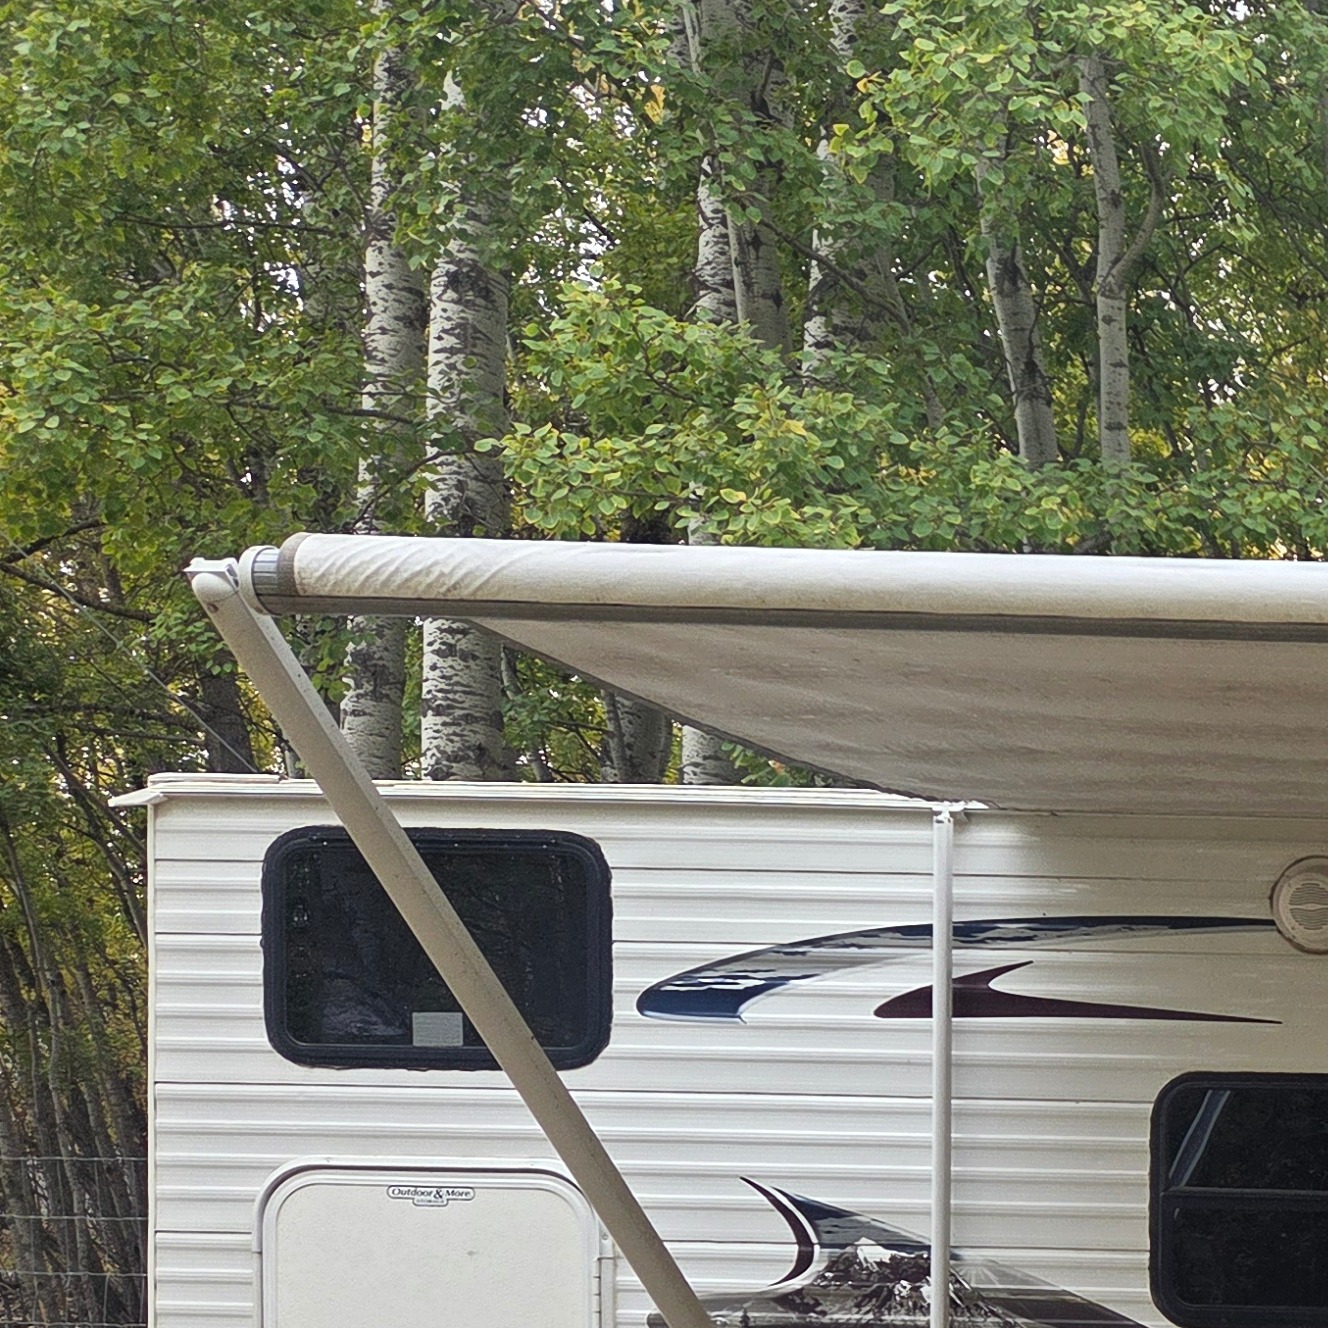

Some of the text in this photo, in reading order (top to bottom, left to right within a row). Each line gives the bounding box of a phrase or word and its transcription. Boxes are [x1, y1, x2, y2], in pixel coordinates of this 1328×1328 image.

[391, 1187, 471, 1199] Outdoor & More
